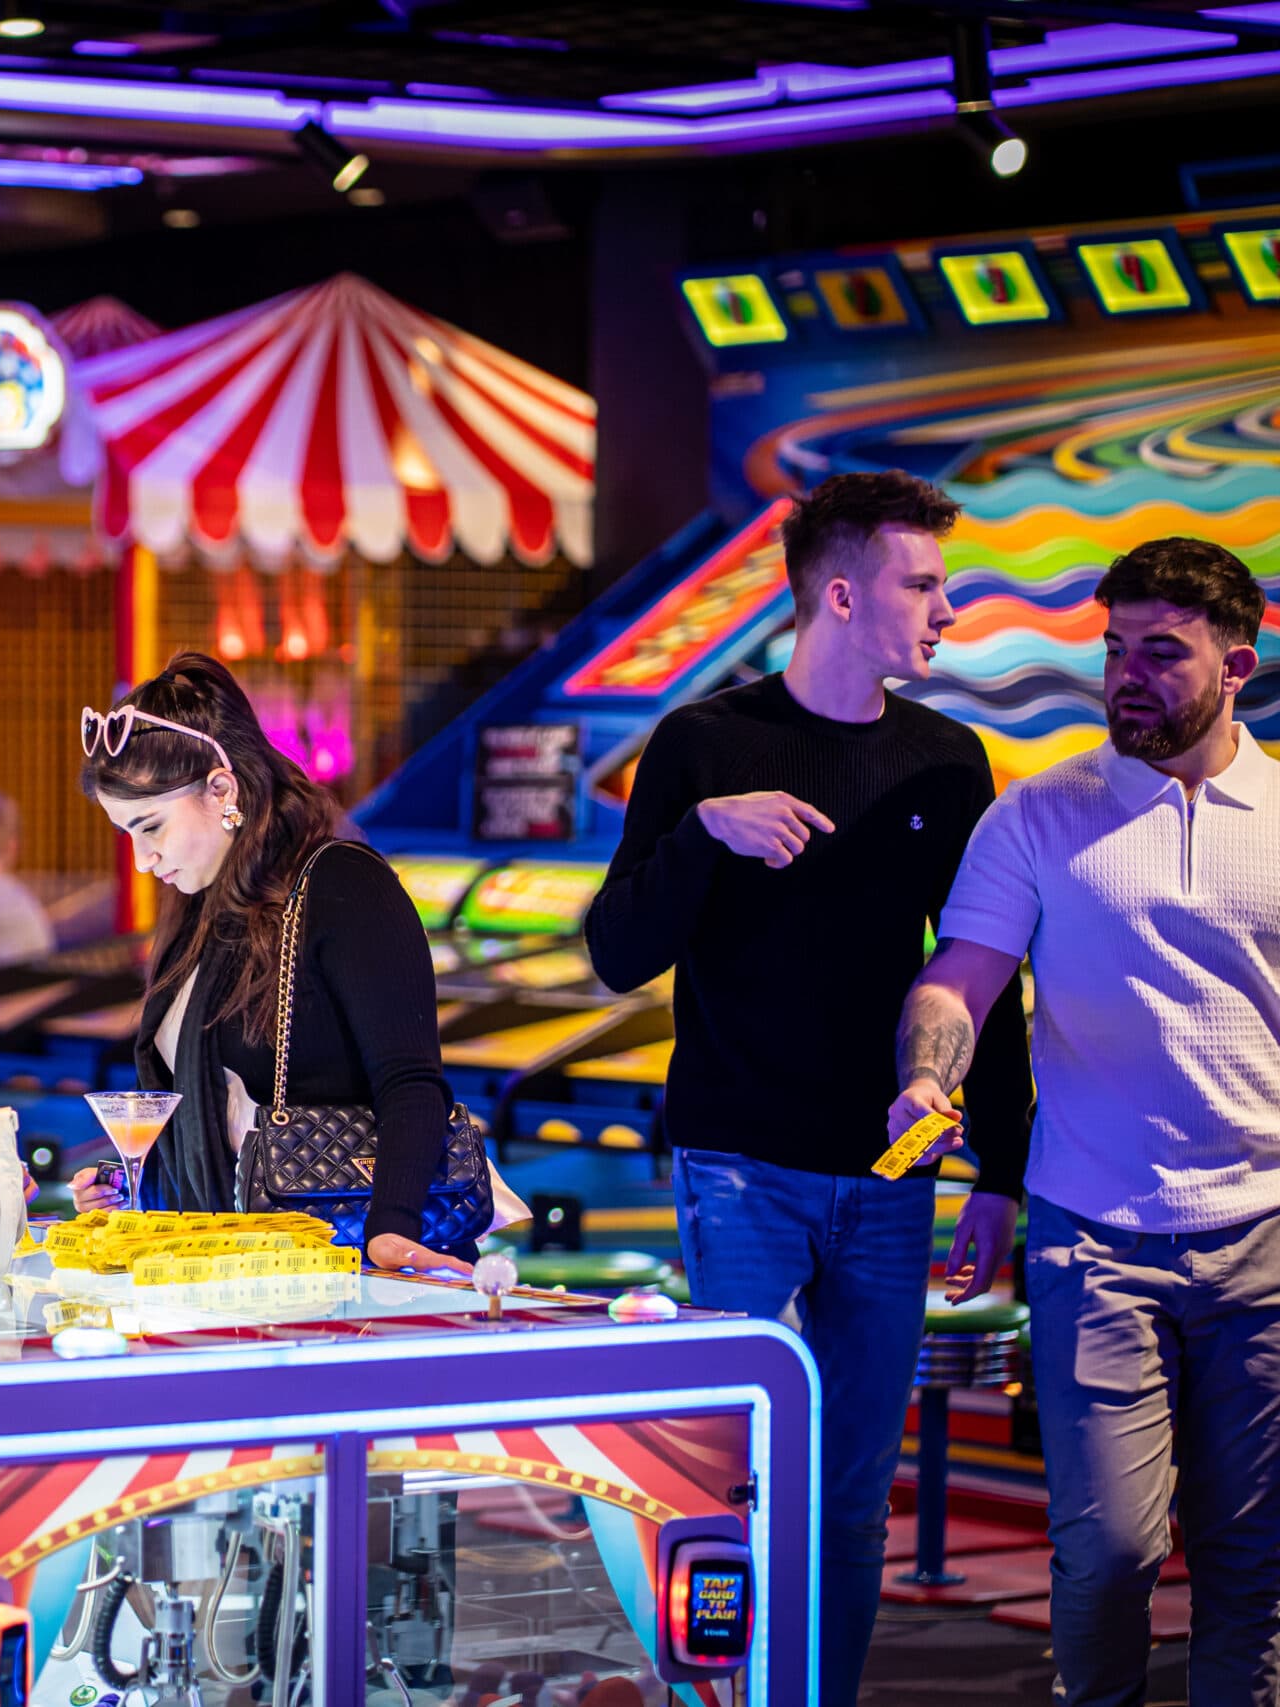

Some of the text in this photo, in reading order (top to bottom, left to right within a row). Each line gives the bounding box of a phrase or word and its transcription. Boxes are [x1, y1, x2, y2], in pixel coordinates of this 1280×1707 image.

[702, 1577, 735, 1589] TAP
[699, 1590, 735, 1600] CARD
[709, 1599, 726, 1609] TO
